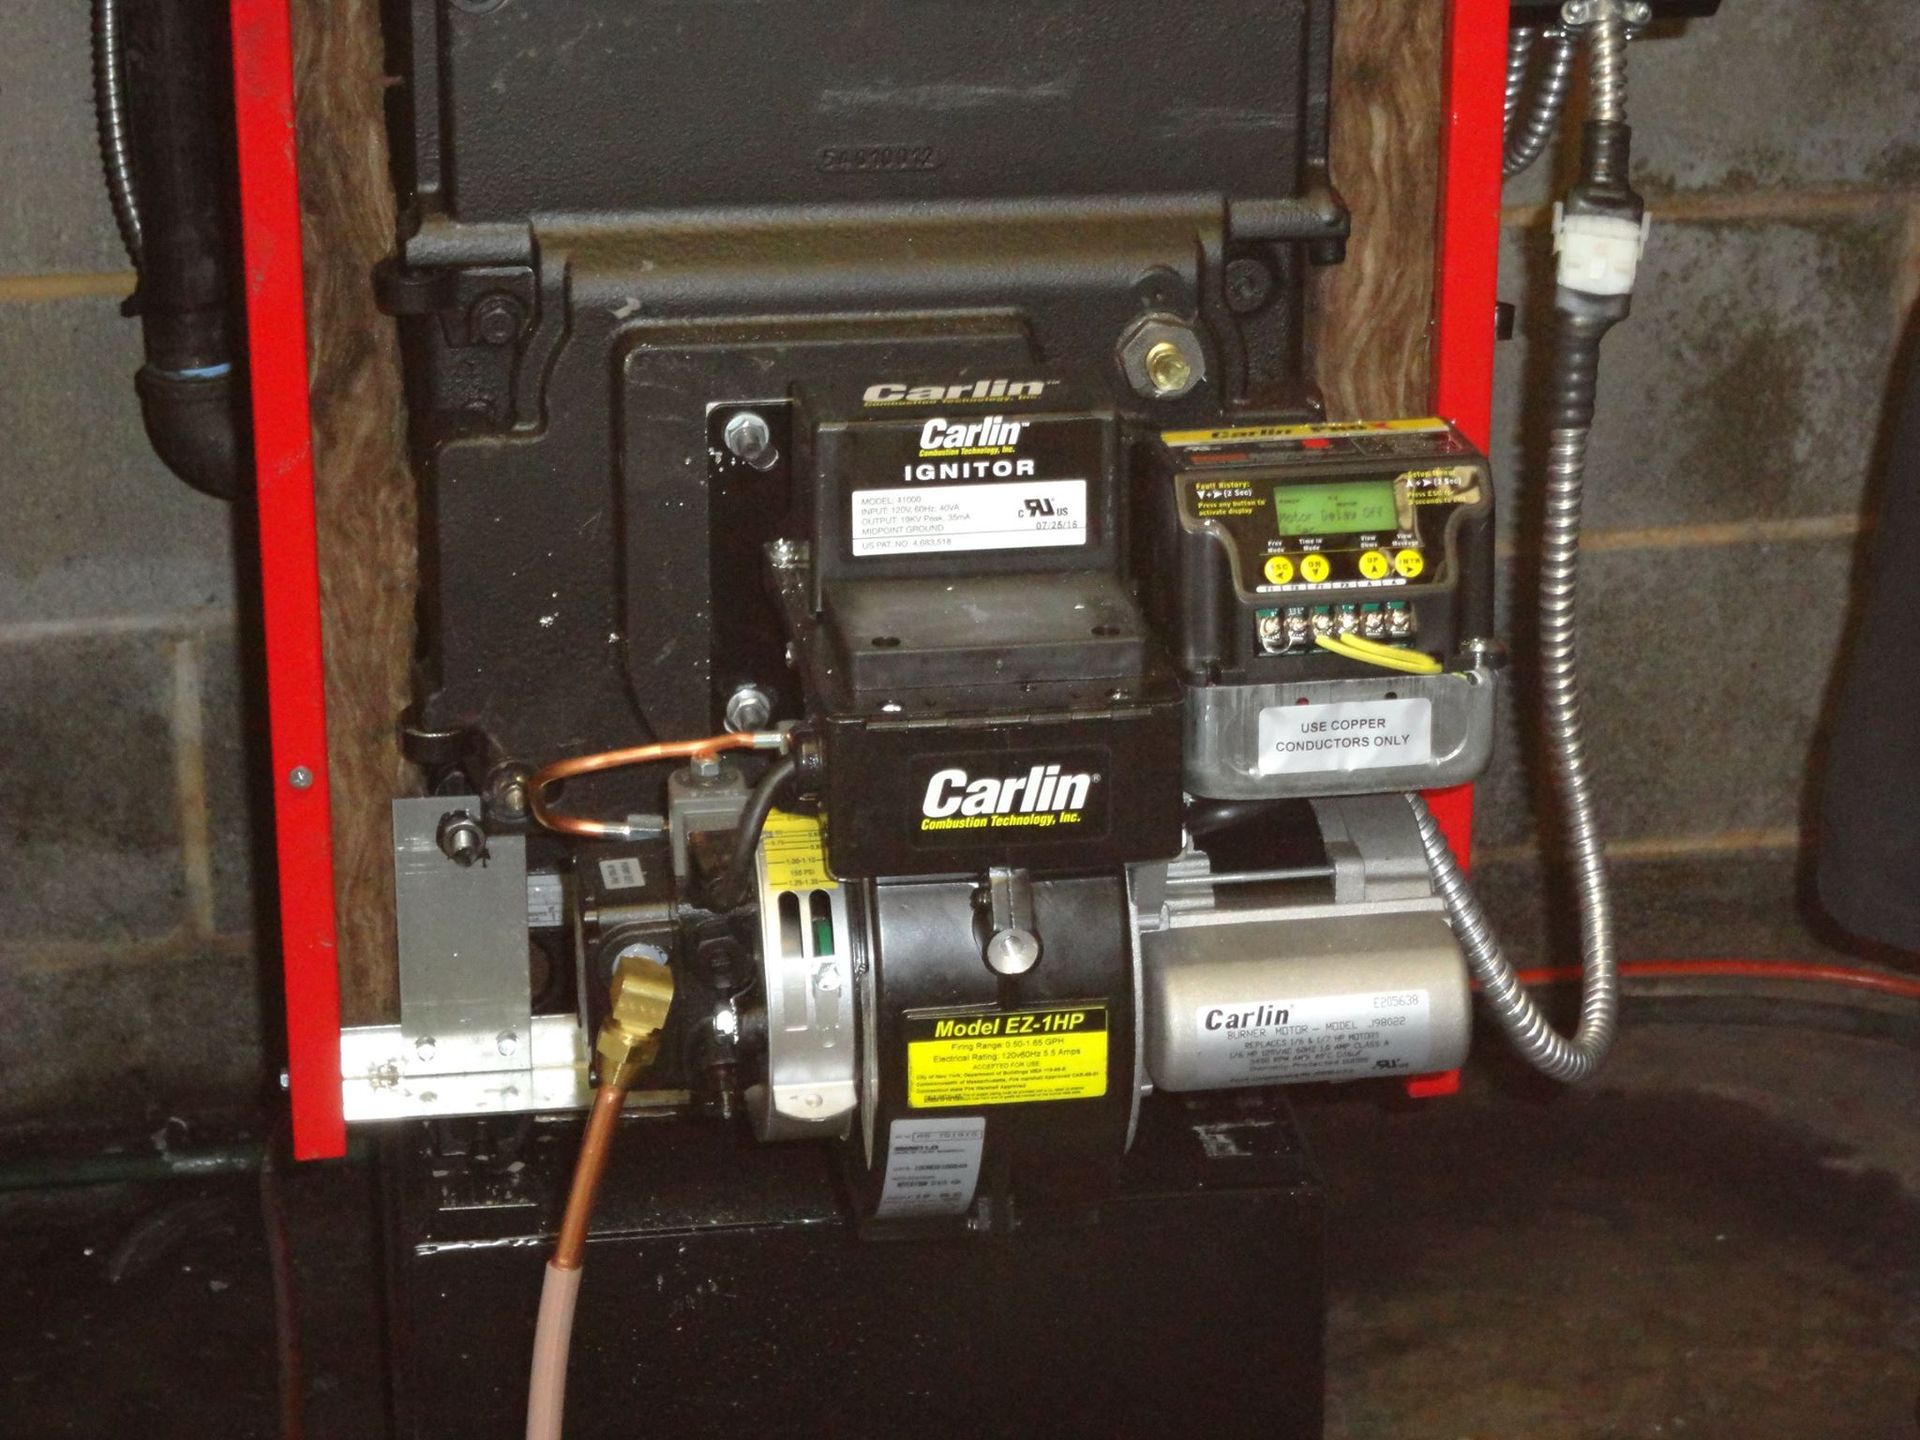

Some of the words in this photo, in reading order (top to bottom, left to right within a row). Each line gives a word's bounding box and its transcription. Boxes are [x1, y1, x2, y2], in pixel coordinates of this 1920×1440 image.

[863, 378, 1045, 402] Carlin
[919, 415, 1022, 450] Carlin
[918, 449, 959, 458] Combustion
[904, 459, 1035, 481] IGNITOR
[862, 526, 903, 536] MIDPOINT
[906, 524, 944, 534] GROUND
[1300, 721, 1328, 734] USE
[1331, 718, 1387, 731] COPPER
[1275, 736, 1370, 753] CONDUCTORS
[1373, 734, 1411, 746] ONLY
[922, 764, 1092, 819] Carlin
[920, 816, 988, 831] Combustion
[990, 813, 1057, 828] Technology,
[1059, 811, 1082, 824] Inc.
[1373, 994, 1419, 1009] E205638
[934, 1014, 1000, 1039] Model
[1004, 1012, 1085, 1035] EZ-1HP
[1204, 1004, 1290, 1032] Carlin
[1227, 1028, 1267, 1041] BURNER
[1275, 1024, 1309, 1036] MOTOR
[1325, 1020, 1358, 1032] MODEL
[1368, 1015, 1407, 1029] J98022
[951, 1042, 974, 1053] Firing
[976, 1040, 1003, 1051] Range:
[1045, 1036, 1065, 1047] GPH
[1244, 1039, 1287, 1050] REPLACES
[1334, 1034, 1346, 1042] HP
[933, 1053, 970, 1064] Electrical
[972, 1051, 1000, 1063] Rating:
[1057, 1047, 1081, 1058] Amps
[973, 1062, 1009, 1070] ACCEPTED
